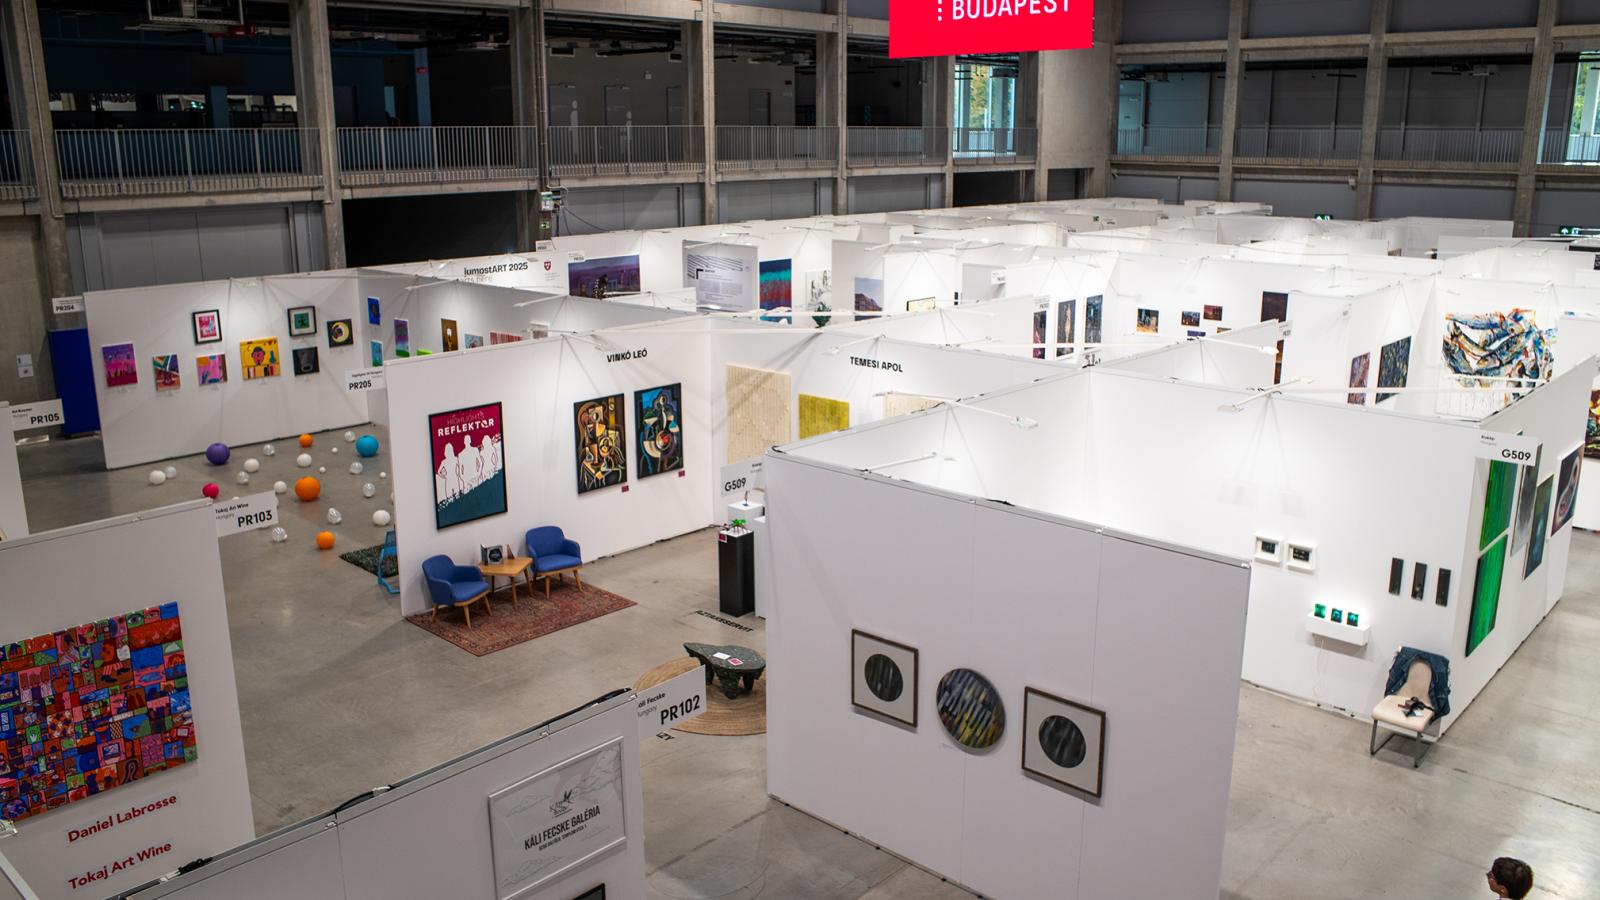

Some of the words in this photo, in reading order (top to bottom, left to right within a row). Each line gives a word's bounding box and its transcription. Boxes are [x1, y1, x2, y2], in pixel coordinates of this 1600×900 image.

[508, 262, 528, 272] 2025
[606, 349, 632, 363] VINKÓ
[632, 347, 648, 359] LEÓ
[849, 356, 880, 369] TEMESI
[881, 361, 903, 373] APOL
[348, 380, 372, 390] PR205
[30, 412, 60, 425] PR105
[437, 418, 495, 437] REFLEKTOR
[1501, 448, 1531, 461] G509
[724, 477, 747, 492] G509
[237, 510, 273, 527] PR103
[660, 694, 701, 725] PR102
[67, 815, 114, 843] Daniel
[116, 795, 178, 823] Labrosse
[524, 832, 542, 851] KÁLI
[542, 819, 570, 842] FECSKE
[571, 804, 601, 828] GALÉRIA
[68, 865, 109, 890] Tokaj
[111, 856, 135, 873] Art
[136, 843, 172, 862] Wine
